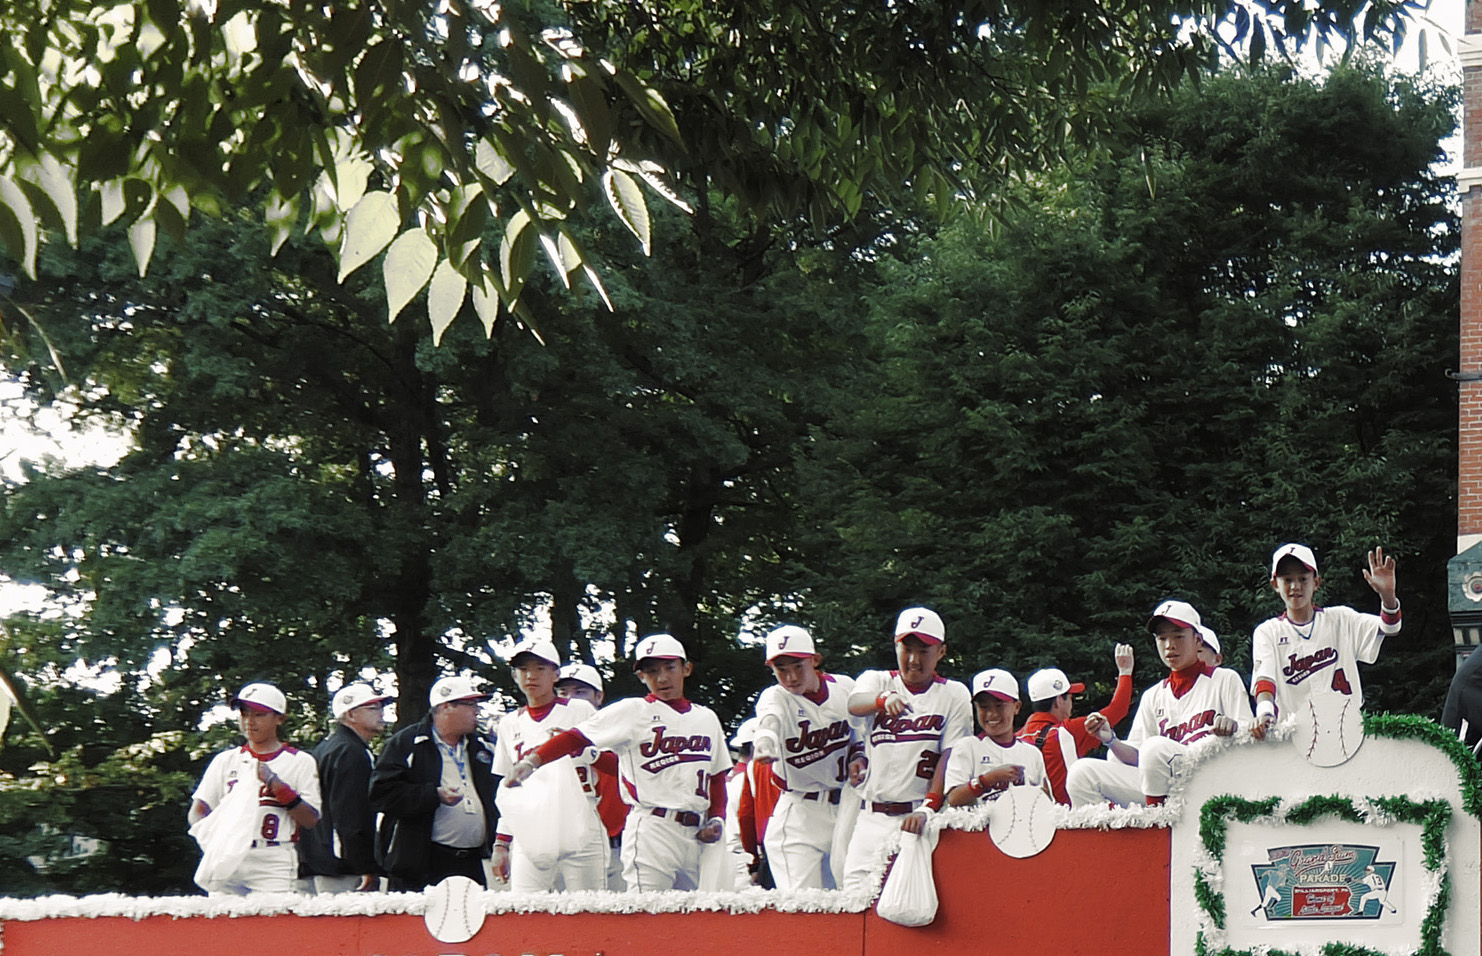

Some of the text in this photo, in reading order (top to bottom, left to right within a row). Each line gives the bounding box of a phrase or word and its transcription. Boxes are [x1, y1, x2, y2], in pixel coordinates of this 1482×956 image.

[911, 616, 924, 629] J
[646, 641, 657, 654] J
[779, 636, 790, 650] J
[1283, 647, 1334, 677] Japan
[983, 675, 996, 688] J
[1331, 667, 1353, 696] 4
[639, 725, 712, 758] Japan
[786, 719, 850, 754] Japan
[261, 813, 280, 840] 8
[1300, 873, 1347, 884] PARADE
[1371, 873, 1384, 887] 13
